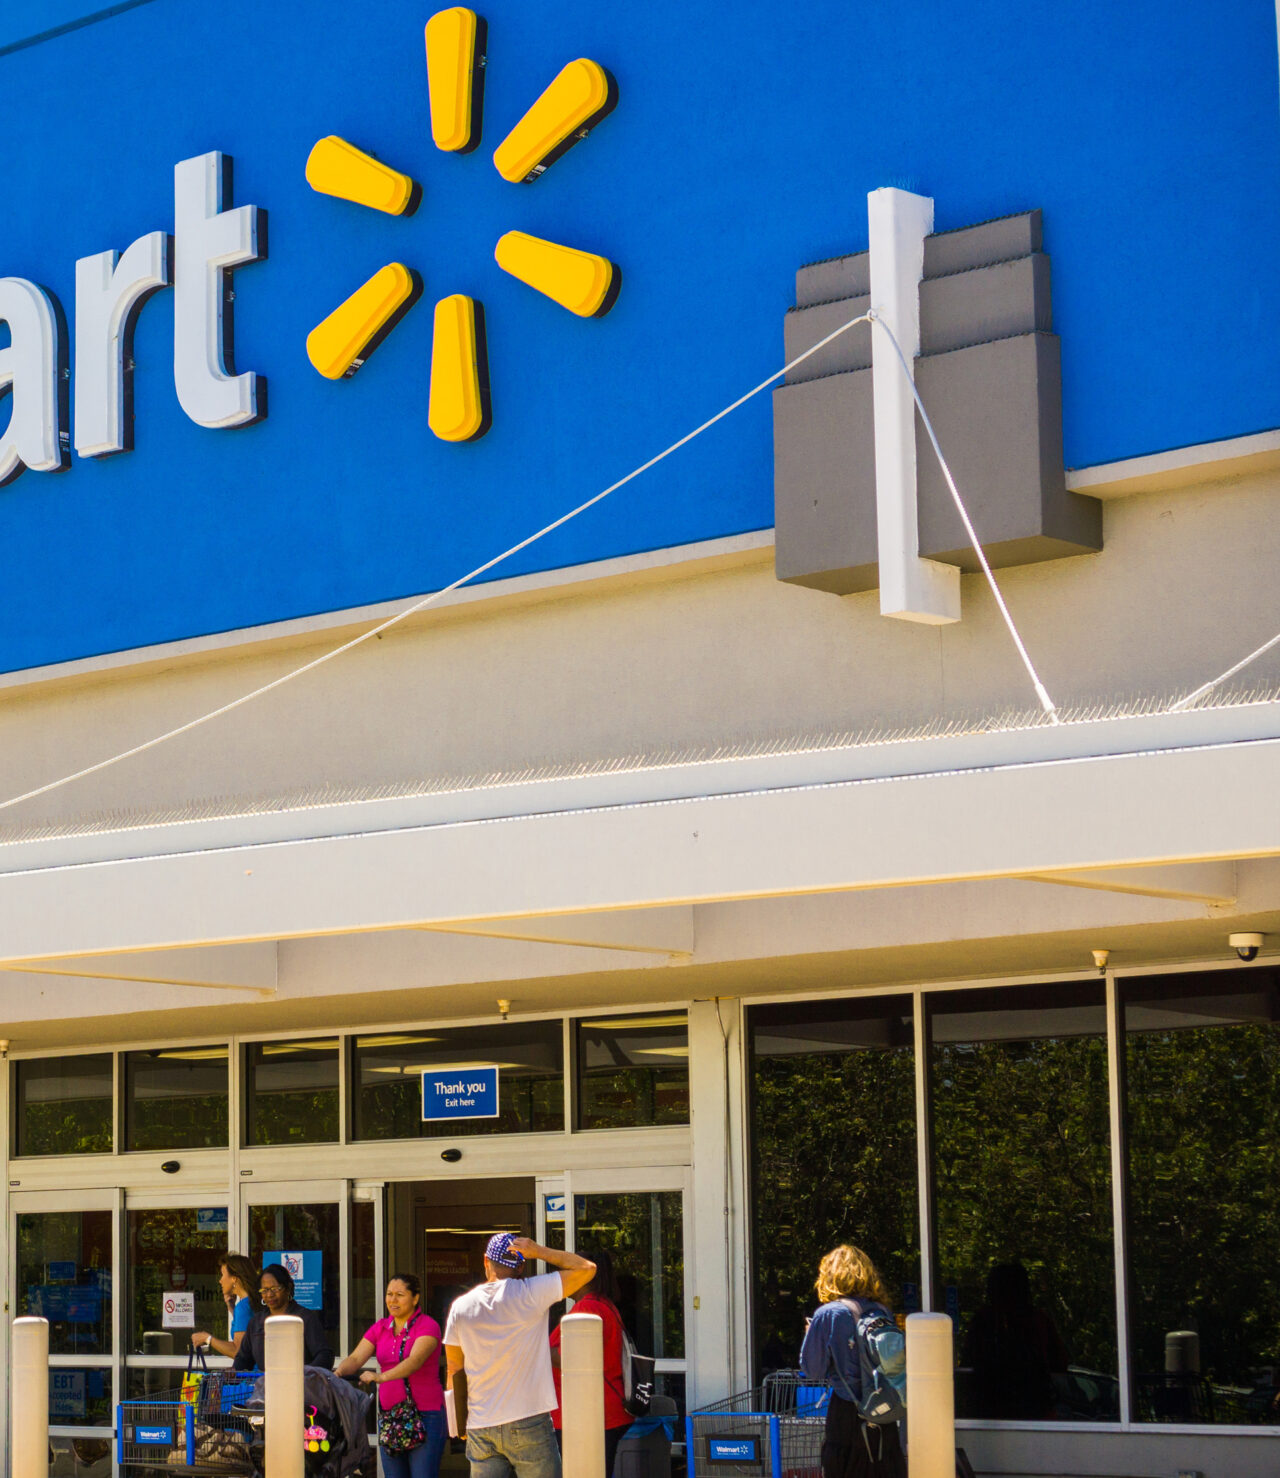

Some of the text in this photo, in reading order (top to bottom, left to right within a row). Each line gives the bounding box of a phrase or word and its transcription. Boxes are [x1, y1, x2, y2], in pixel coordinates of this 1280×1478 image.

[434, 1081, 486, 1096] Thank you
[445, 1097, 475, 1107] Exit here
[54, 1375, 74, 1389] EBT
